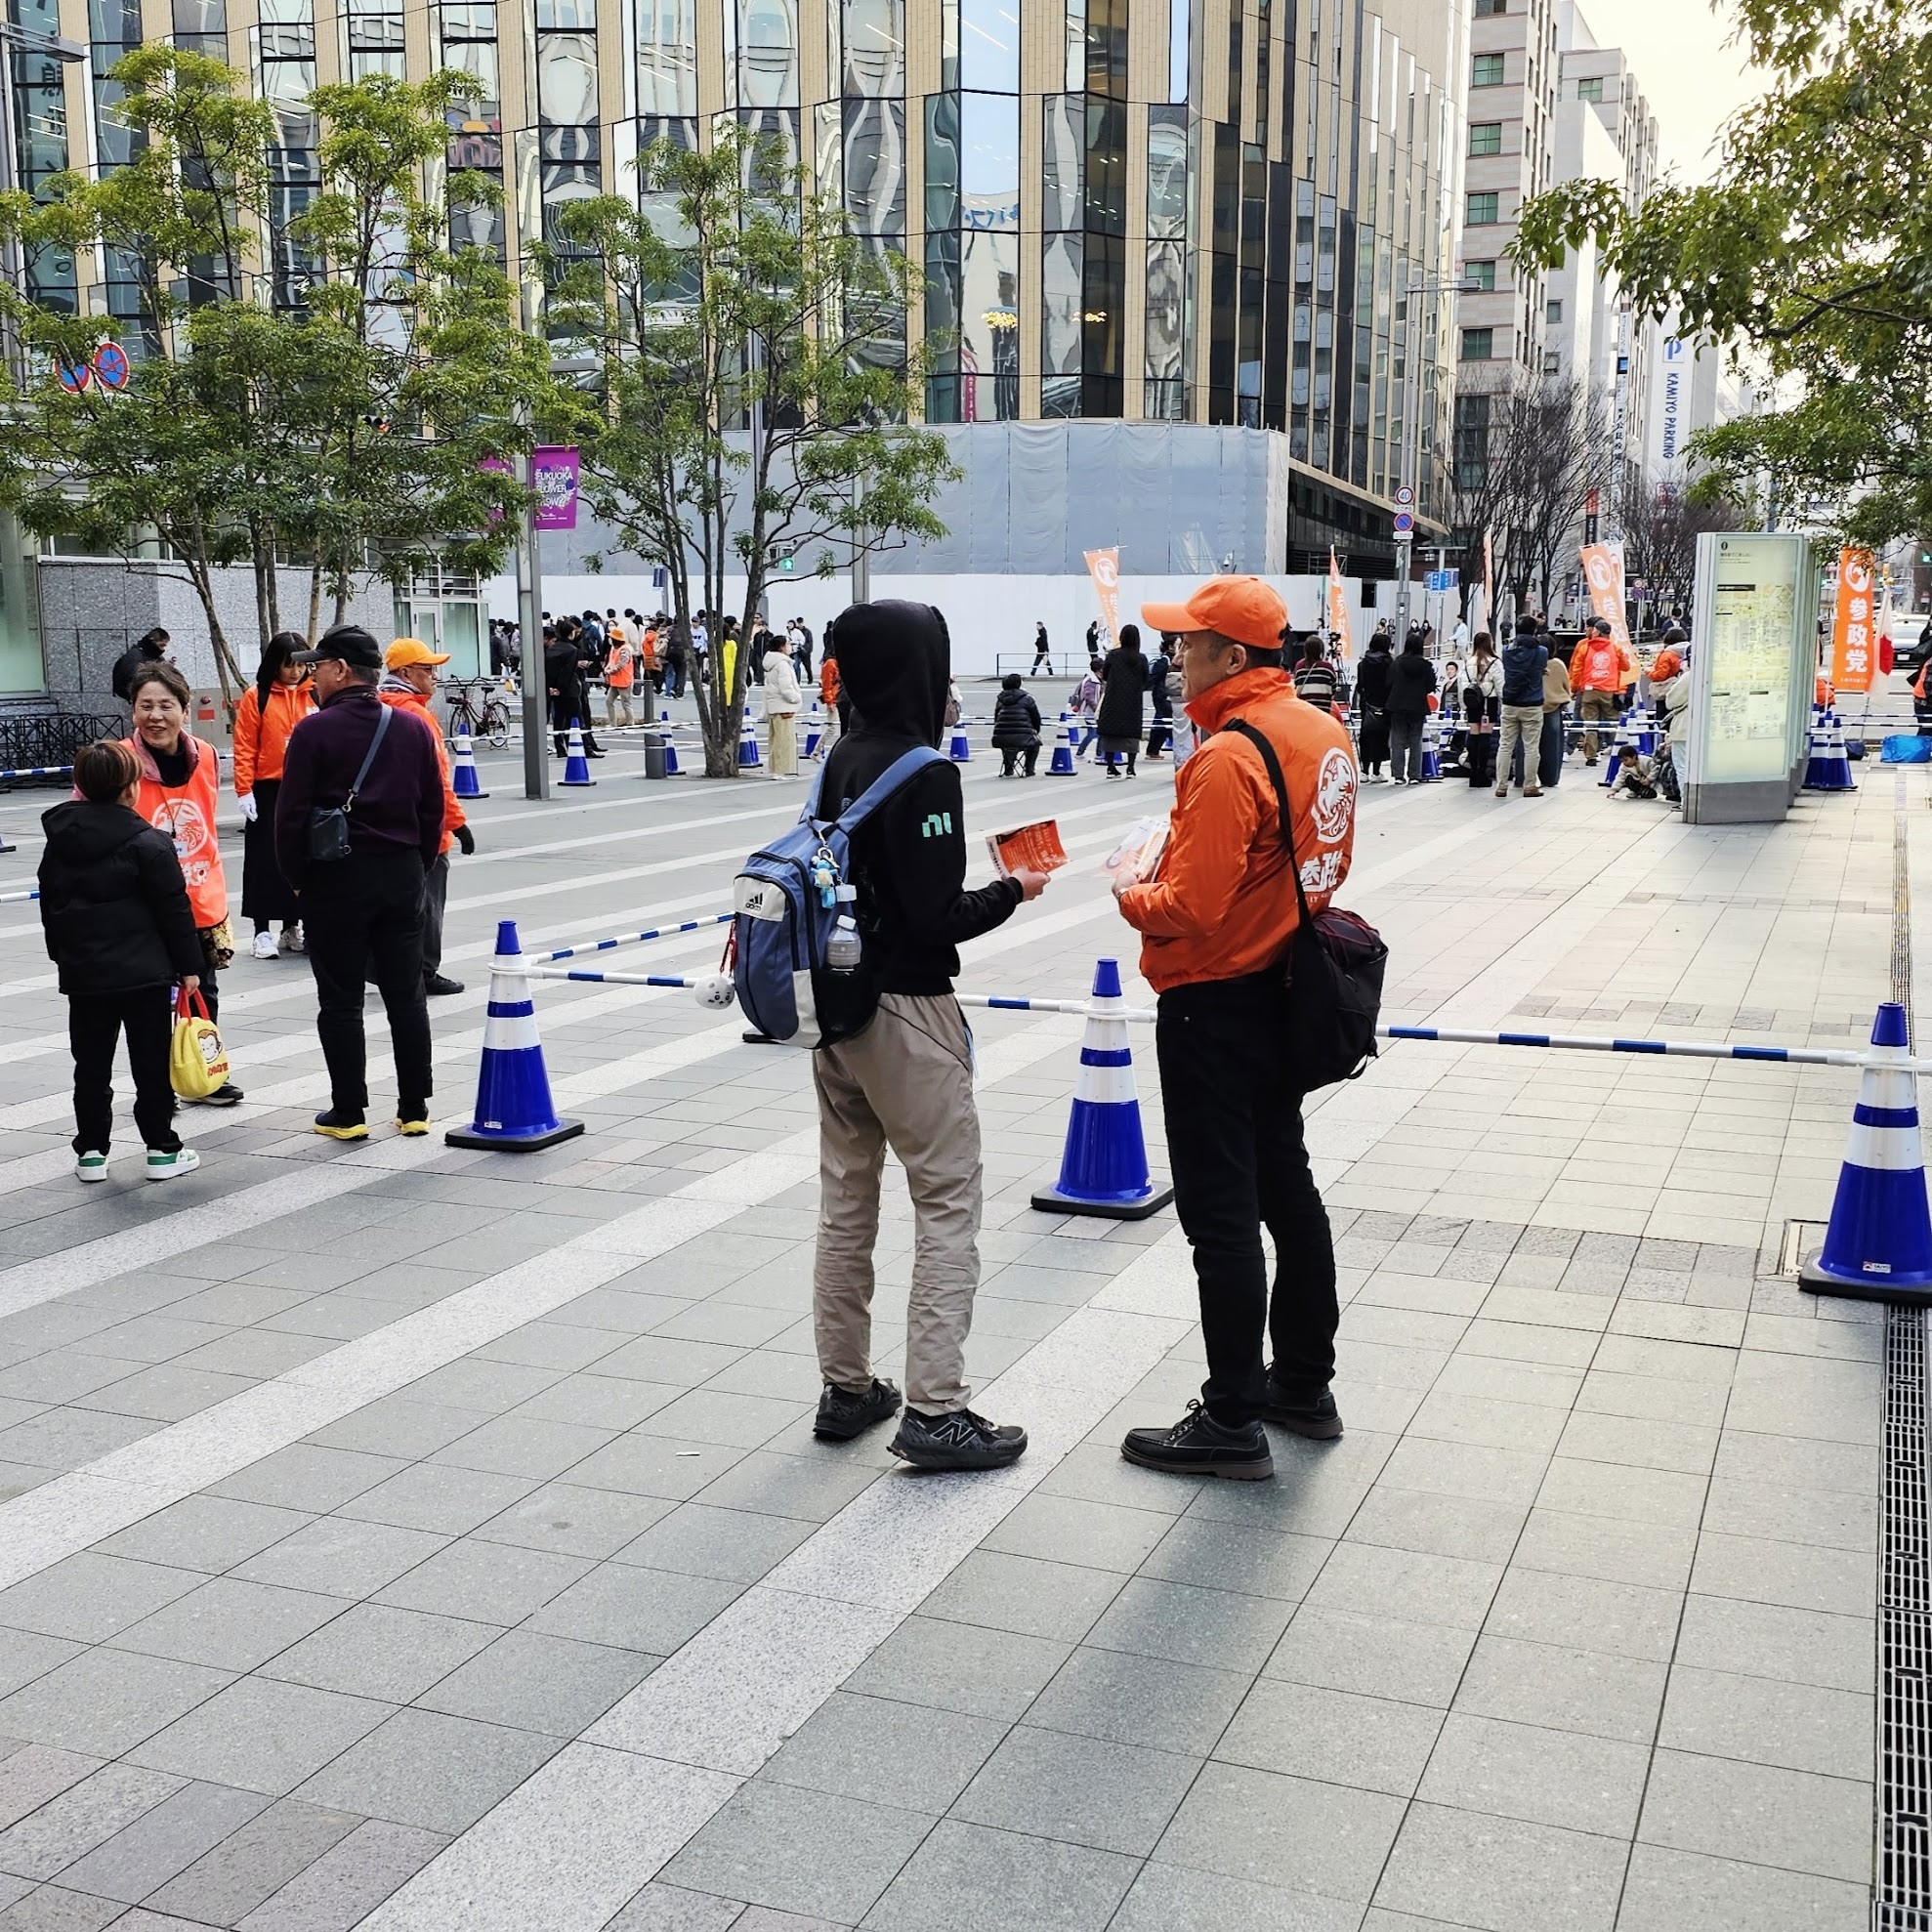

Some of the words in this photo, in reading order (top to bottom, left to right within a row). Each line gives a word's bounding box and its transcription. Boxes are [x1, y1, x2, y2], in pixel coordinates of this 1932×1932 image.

[1665, 372, 1679, 413] KAMIYO
[1662, 417, 1677, 459] PARKING
[536, 471, 573, 482] FUKUOKA
[1399, 491, 1410, 500] 40
[1845, 597, 1869, 673] 参政党
